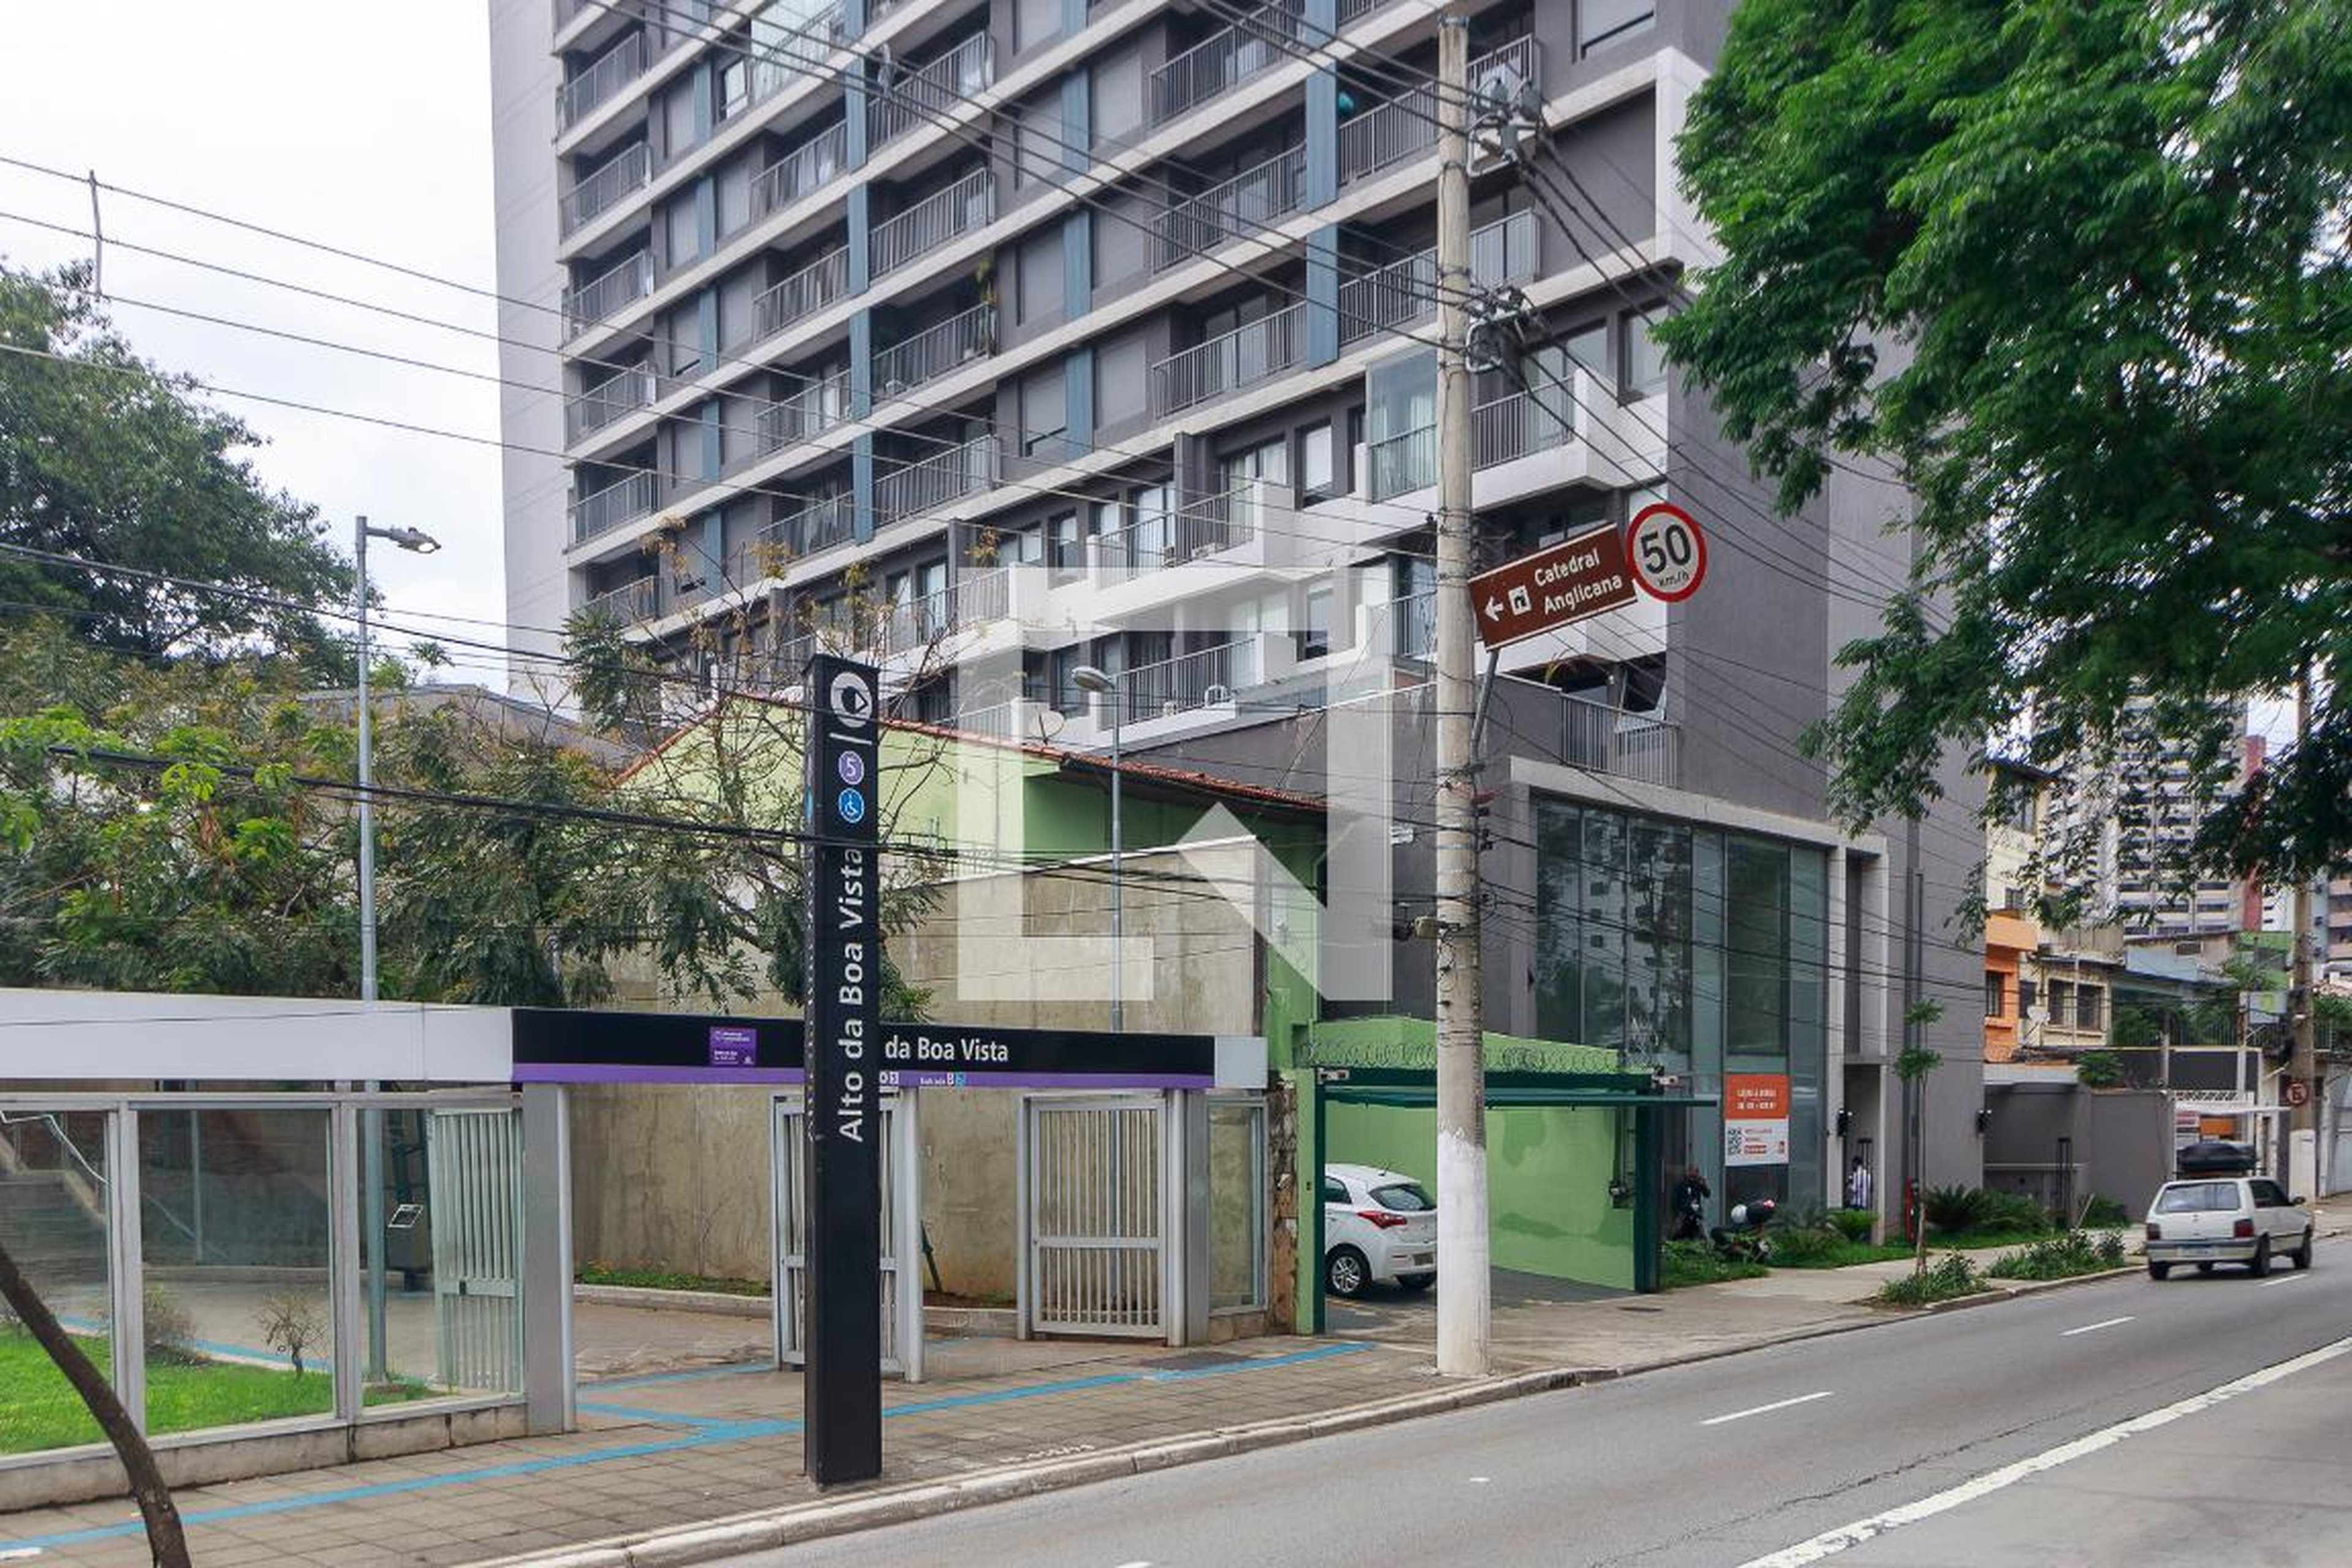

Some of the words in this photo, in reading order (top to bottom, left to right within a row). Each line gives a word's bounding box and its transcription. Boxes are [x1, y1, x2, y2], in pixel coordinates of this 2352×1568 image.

[1534, 548, 1600, 586] Catedral
[1641, 524, 1691, 574] 50
[1544, 575, 1623, 615] Anglicana
[846, 756, 857, 777] 5
[839, 848, 863, 930] Vista
[839, 942, 863, 1005] Boa
[837, 1018, 863, 1059] da
[885, 1035, 910, 1060] da
[918, 1036, 955, 1061] Boa
[960, 1038, 1009, 1062] Vista
[837, 1071, 863, 1142] Alto
